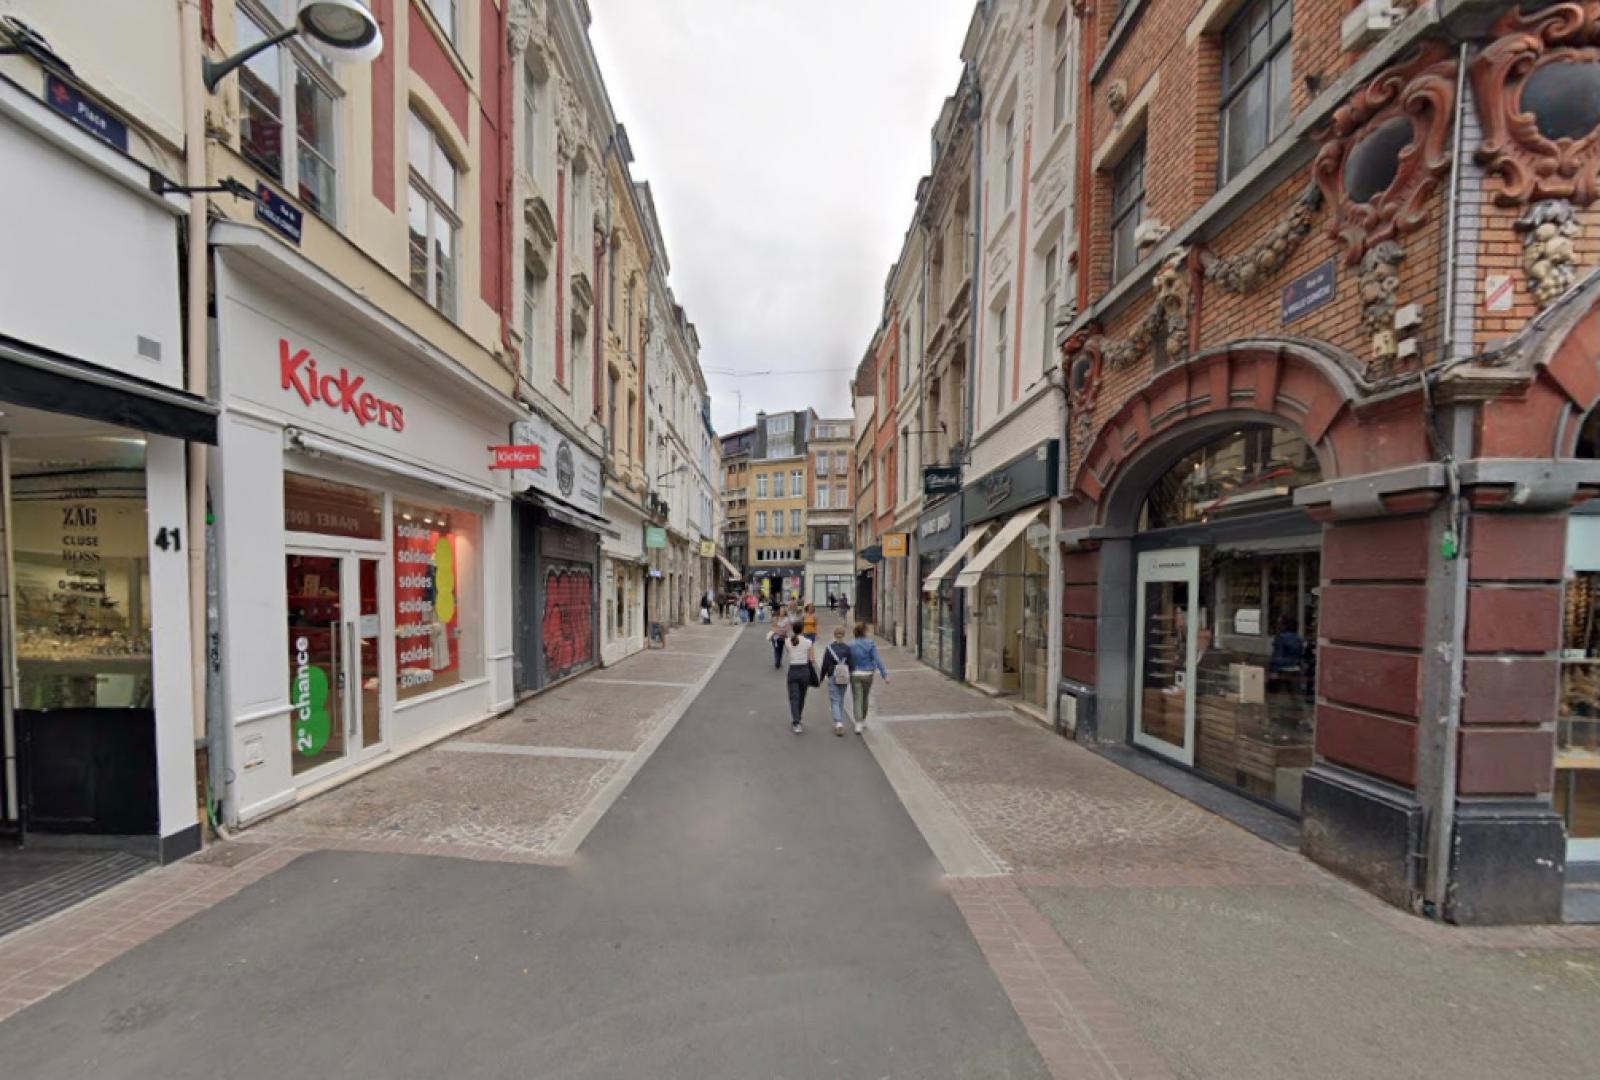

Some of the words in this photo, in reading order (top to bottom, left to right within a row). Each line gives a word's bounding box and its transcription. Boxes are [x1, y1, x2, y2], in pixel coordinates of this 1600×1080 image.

[77, 101, 107, 129] Place
[62, 535, 98, 546] CLUSE
[155, 527, 180, 552] 41
[399, 572, 432, 588] soldes
[399, 597, 432, 613] soldes
[400, 643, 433, 664] soldes
[295, 636, 311, 720] chance
